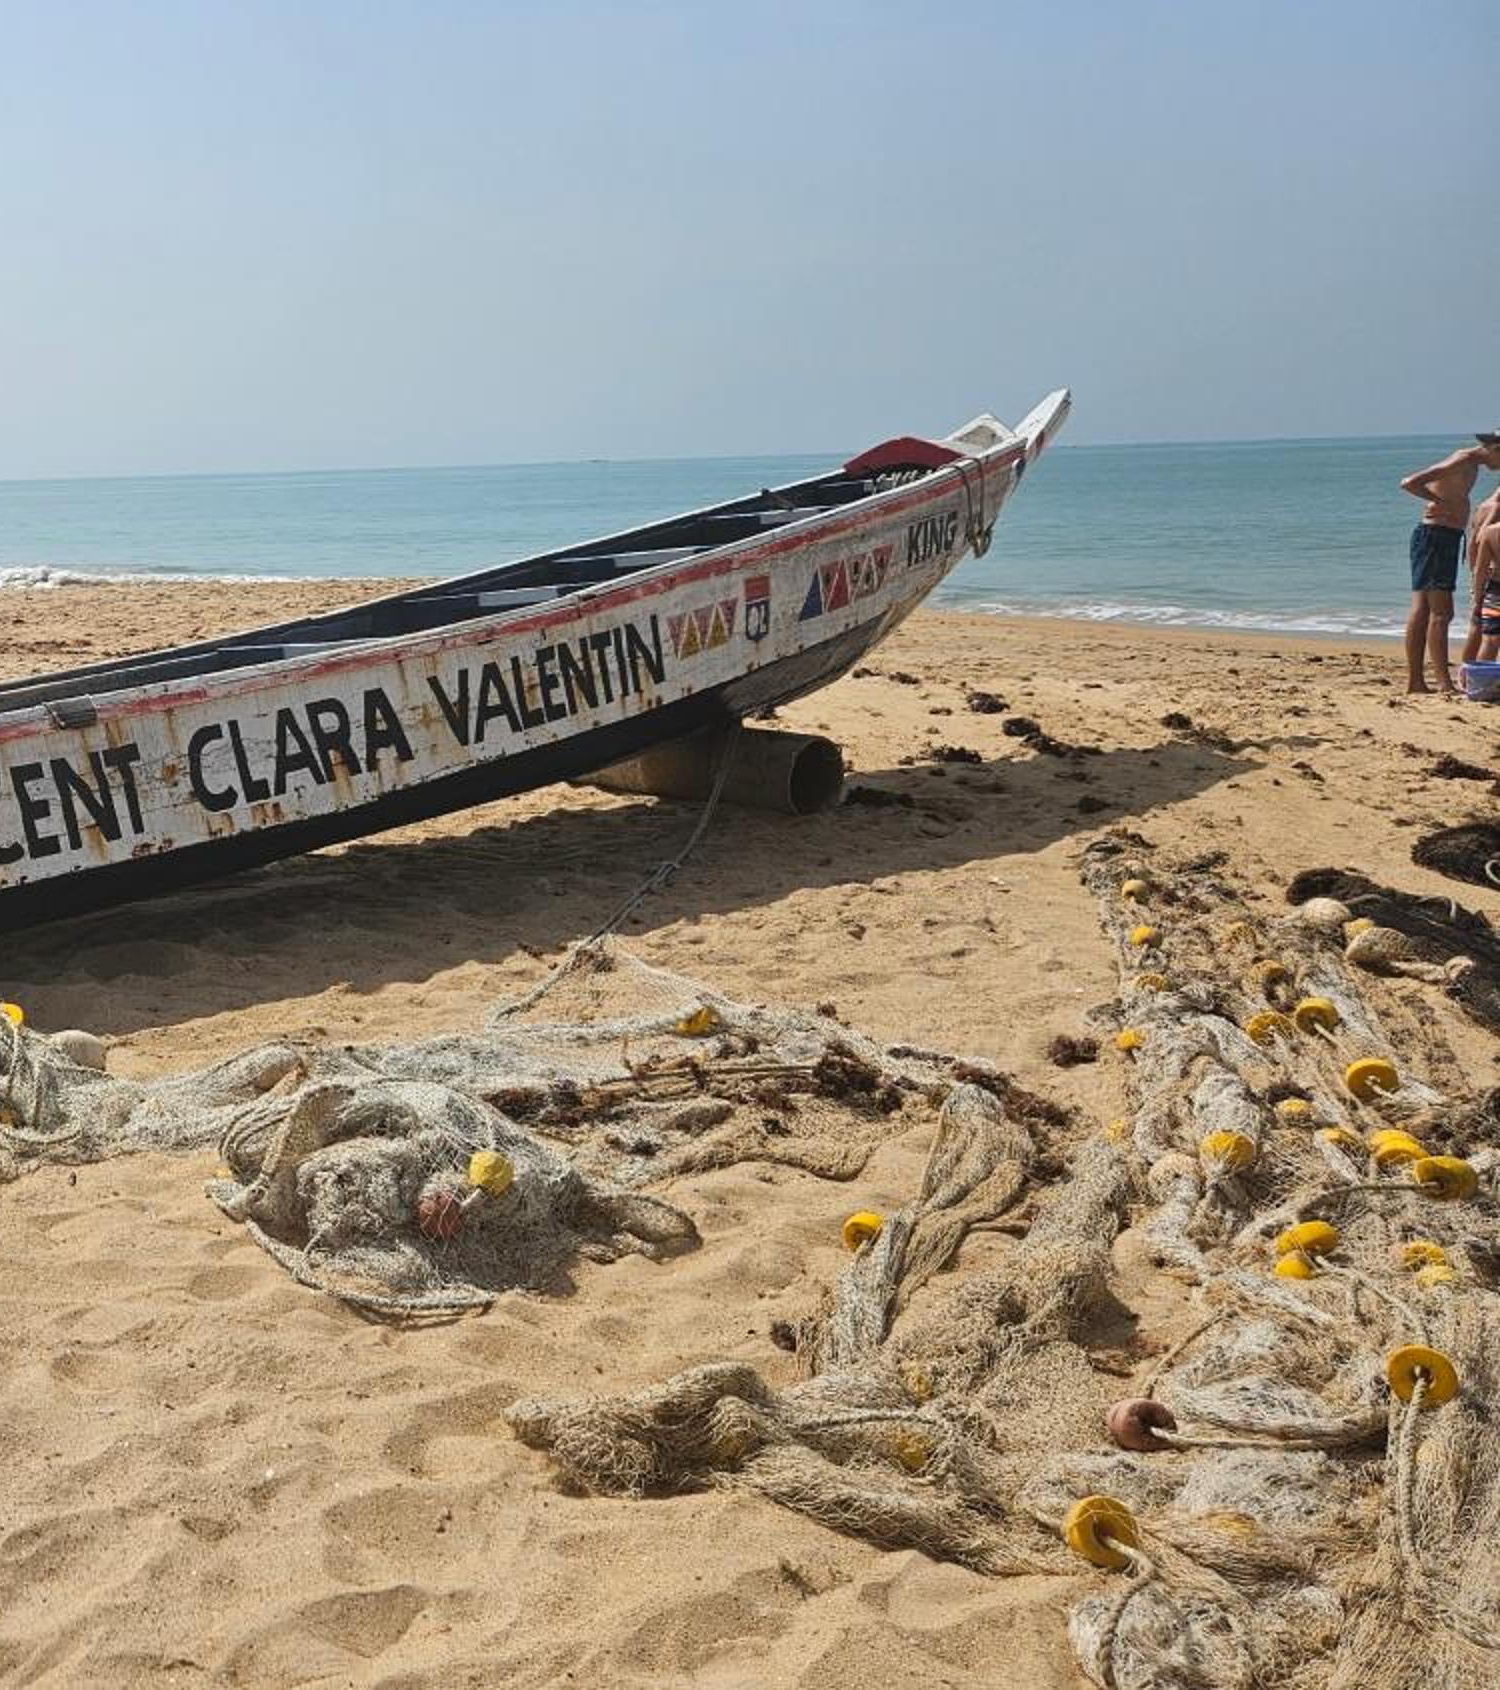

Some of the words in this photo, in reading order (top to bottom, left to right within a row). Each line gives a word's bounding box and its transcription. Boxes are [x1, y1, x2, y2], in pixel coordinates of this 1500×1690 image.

[908, 512, 957, 567] KING
[187, 687, 414, 812] CLARA
[426, 613, 665, 746] VALENTIN
